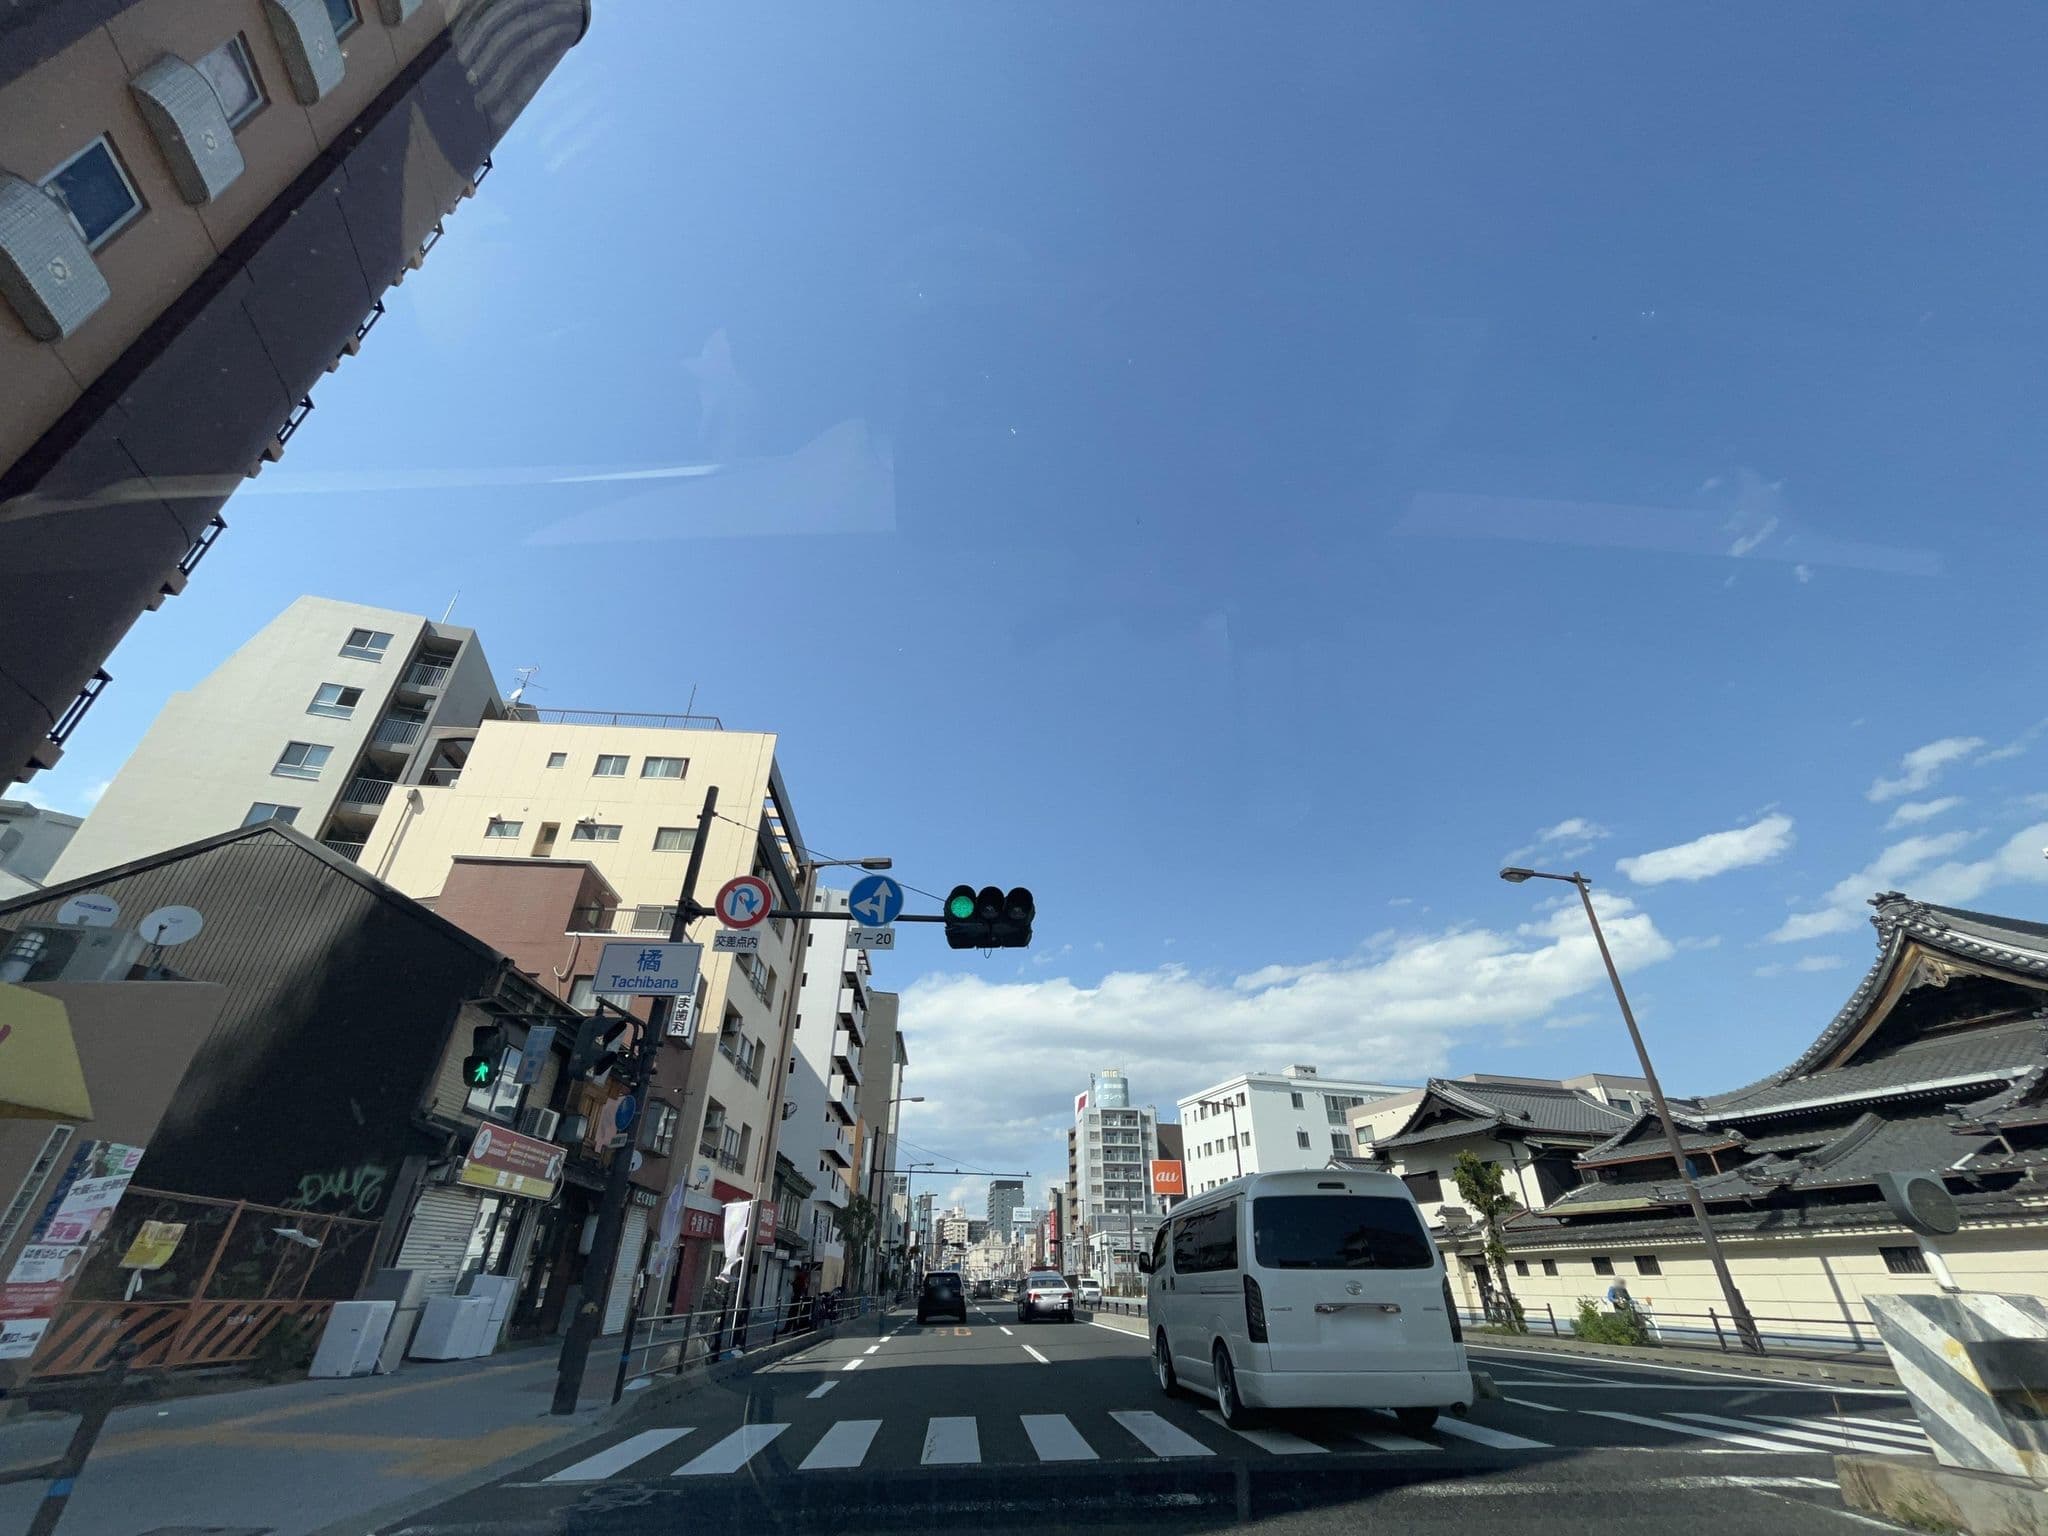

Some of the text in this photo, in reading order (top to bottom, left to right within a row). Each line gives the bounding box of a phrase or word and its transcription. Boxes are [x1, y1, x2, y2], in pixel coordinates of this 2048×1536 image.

[714, 935, 758, 949] 交差点内
[636, 948, 663, 973] 橘
[611, 975, 679, 989] Tachibana
[671, 994, 691, 1035] ま歯科
[1156, 1171, 1180, 1183] au
